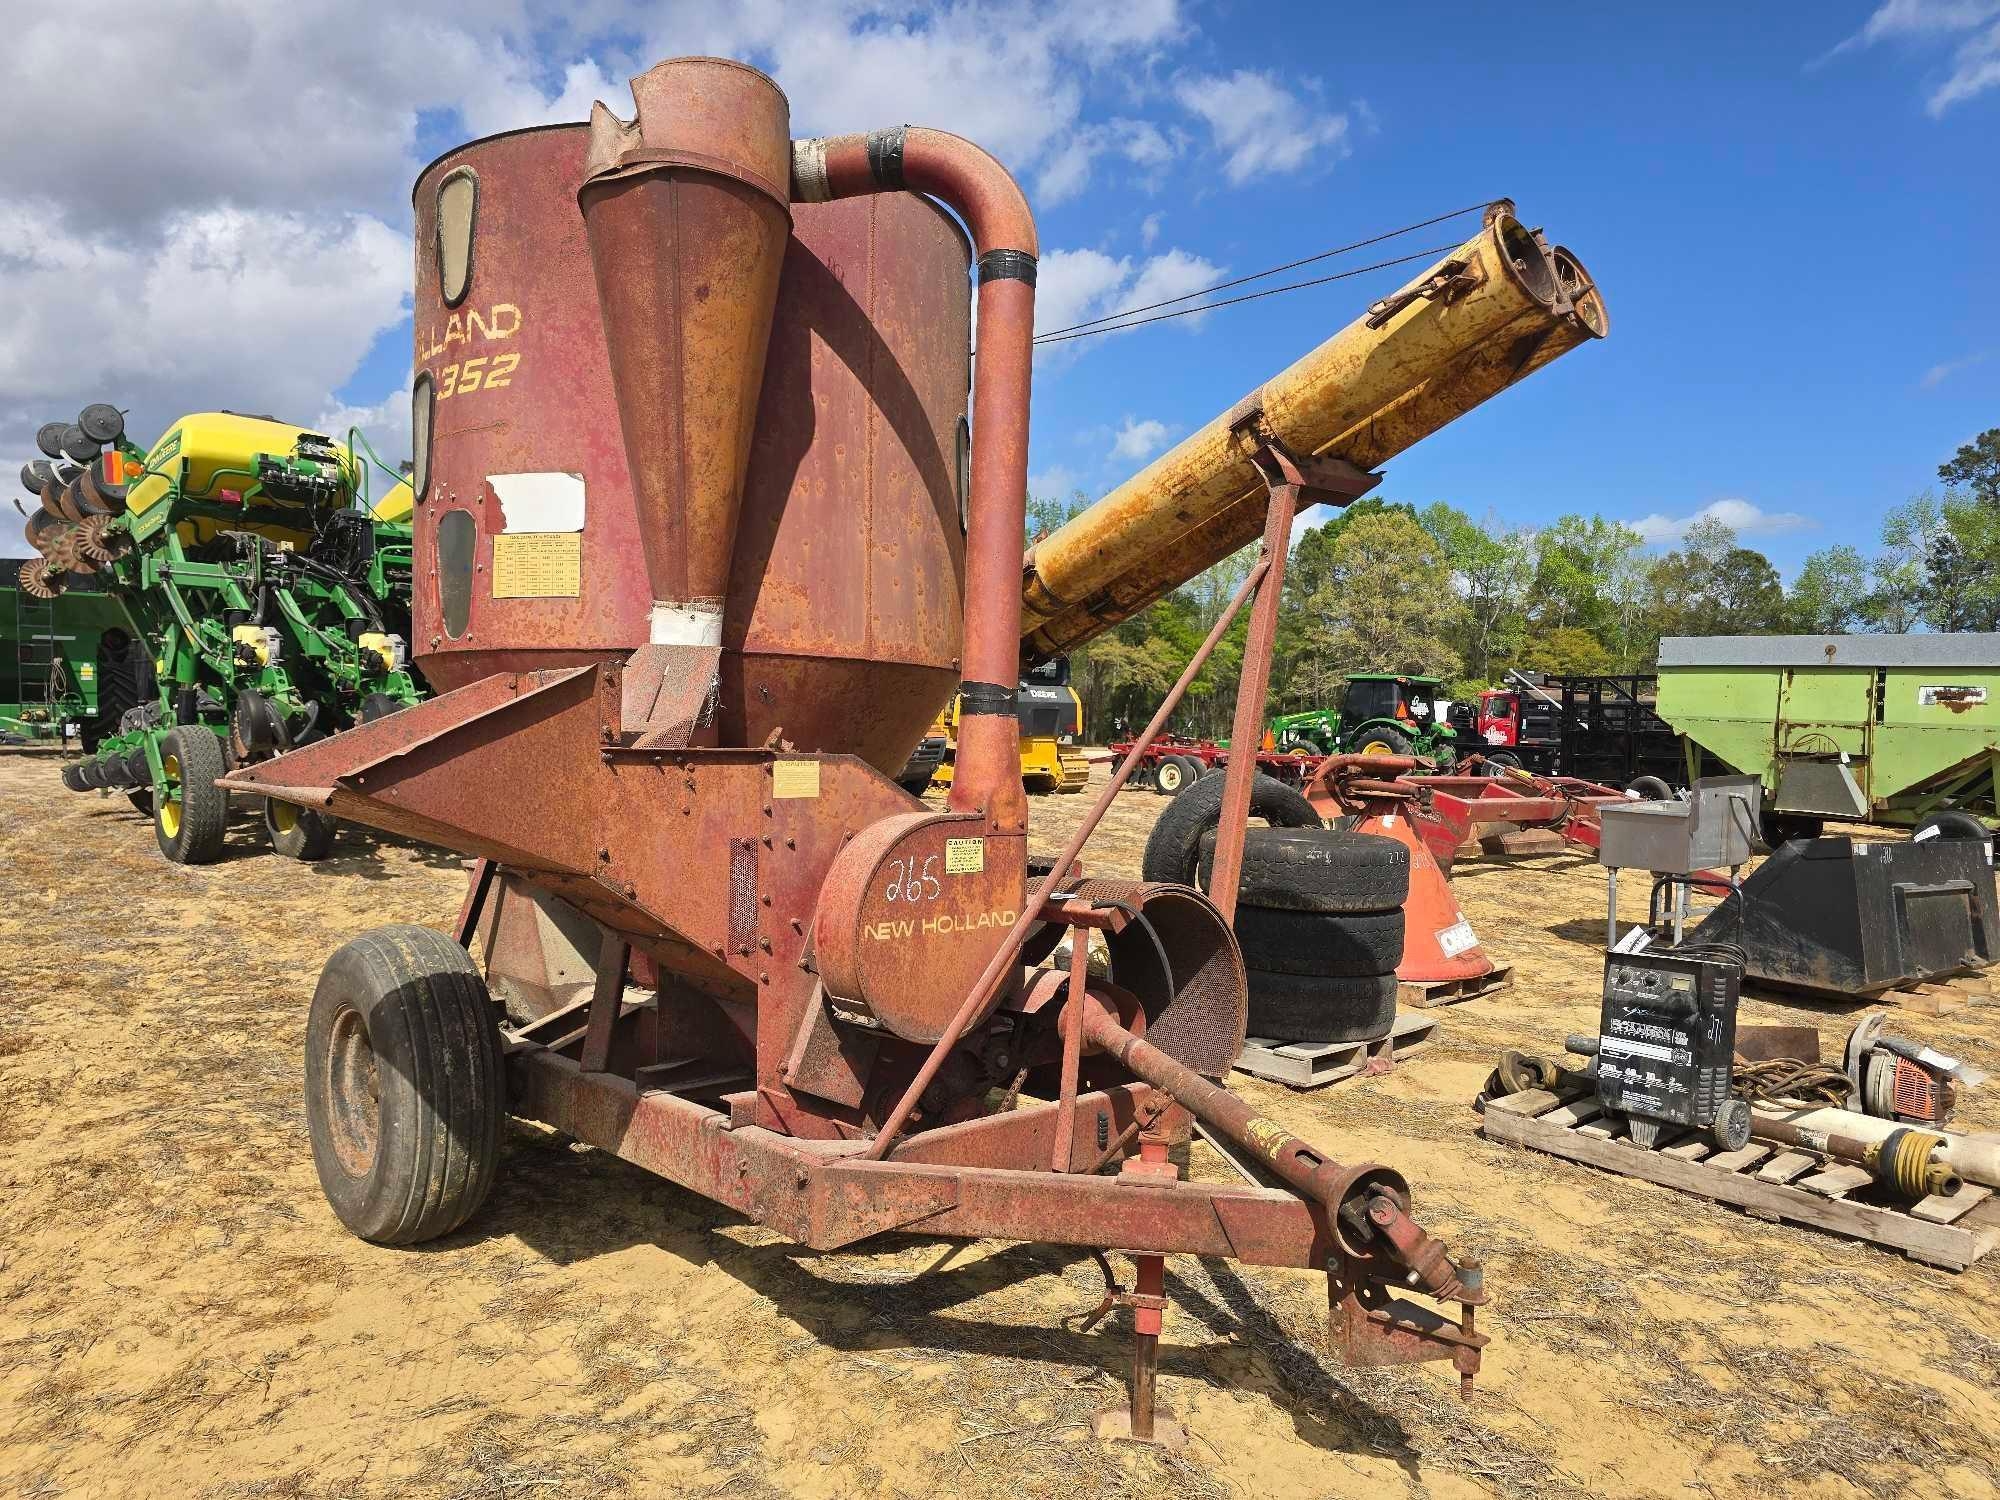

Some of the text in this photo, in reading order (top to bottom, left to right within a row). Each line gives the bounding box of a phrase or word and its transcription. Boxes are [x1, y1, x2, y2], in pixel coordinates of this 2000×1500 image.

[437, 352, 520, 400] 352
[886, 855, 941, 902] 265
[864, 910, 1017, 940] NEW HOLLAND
